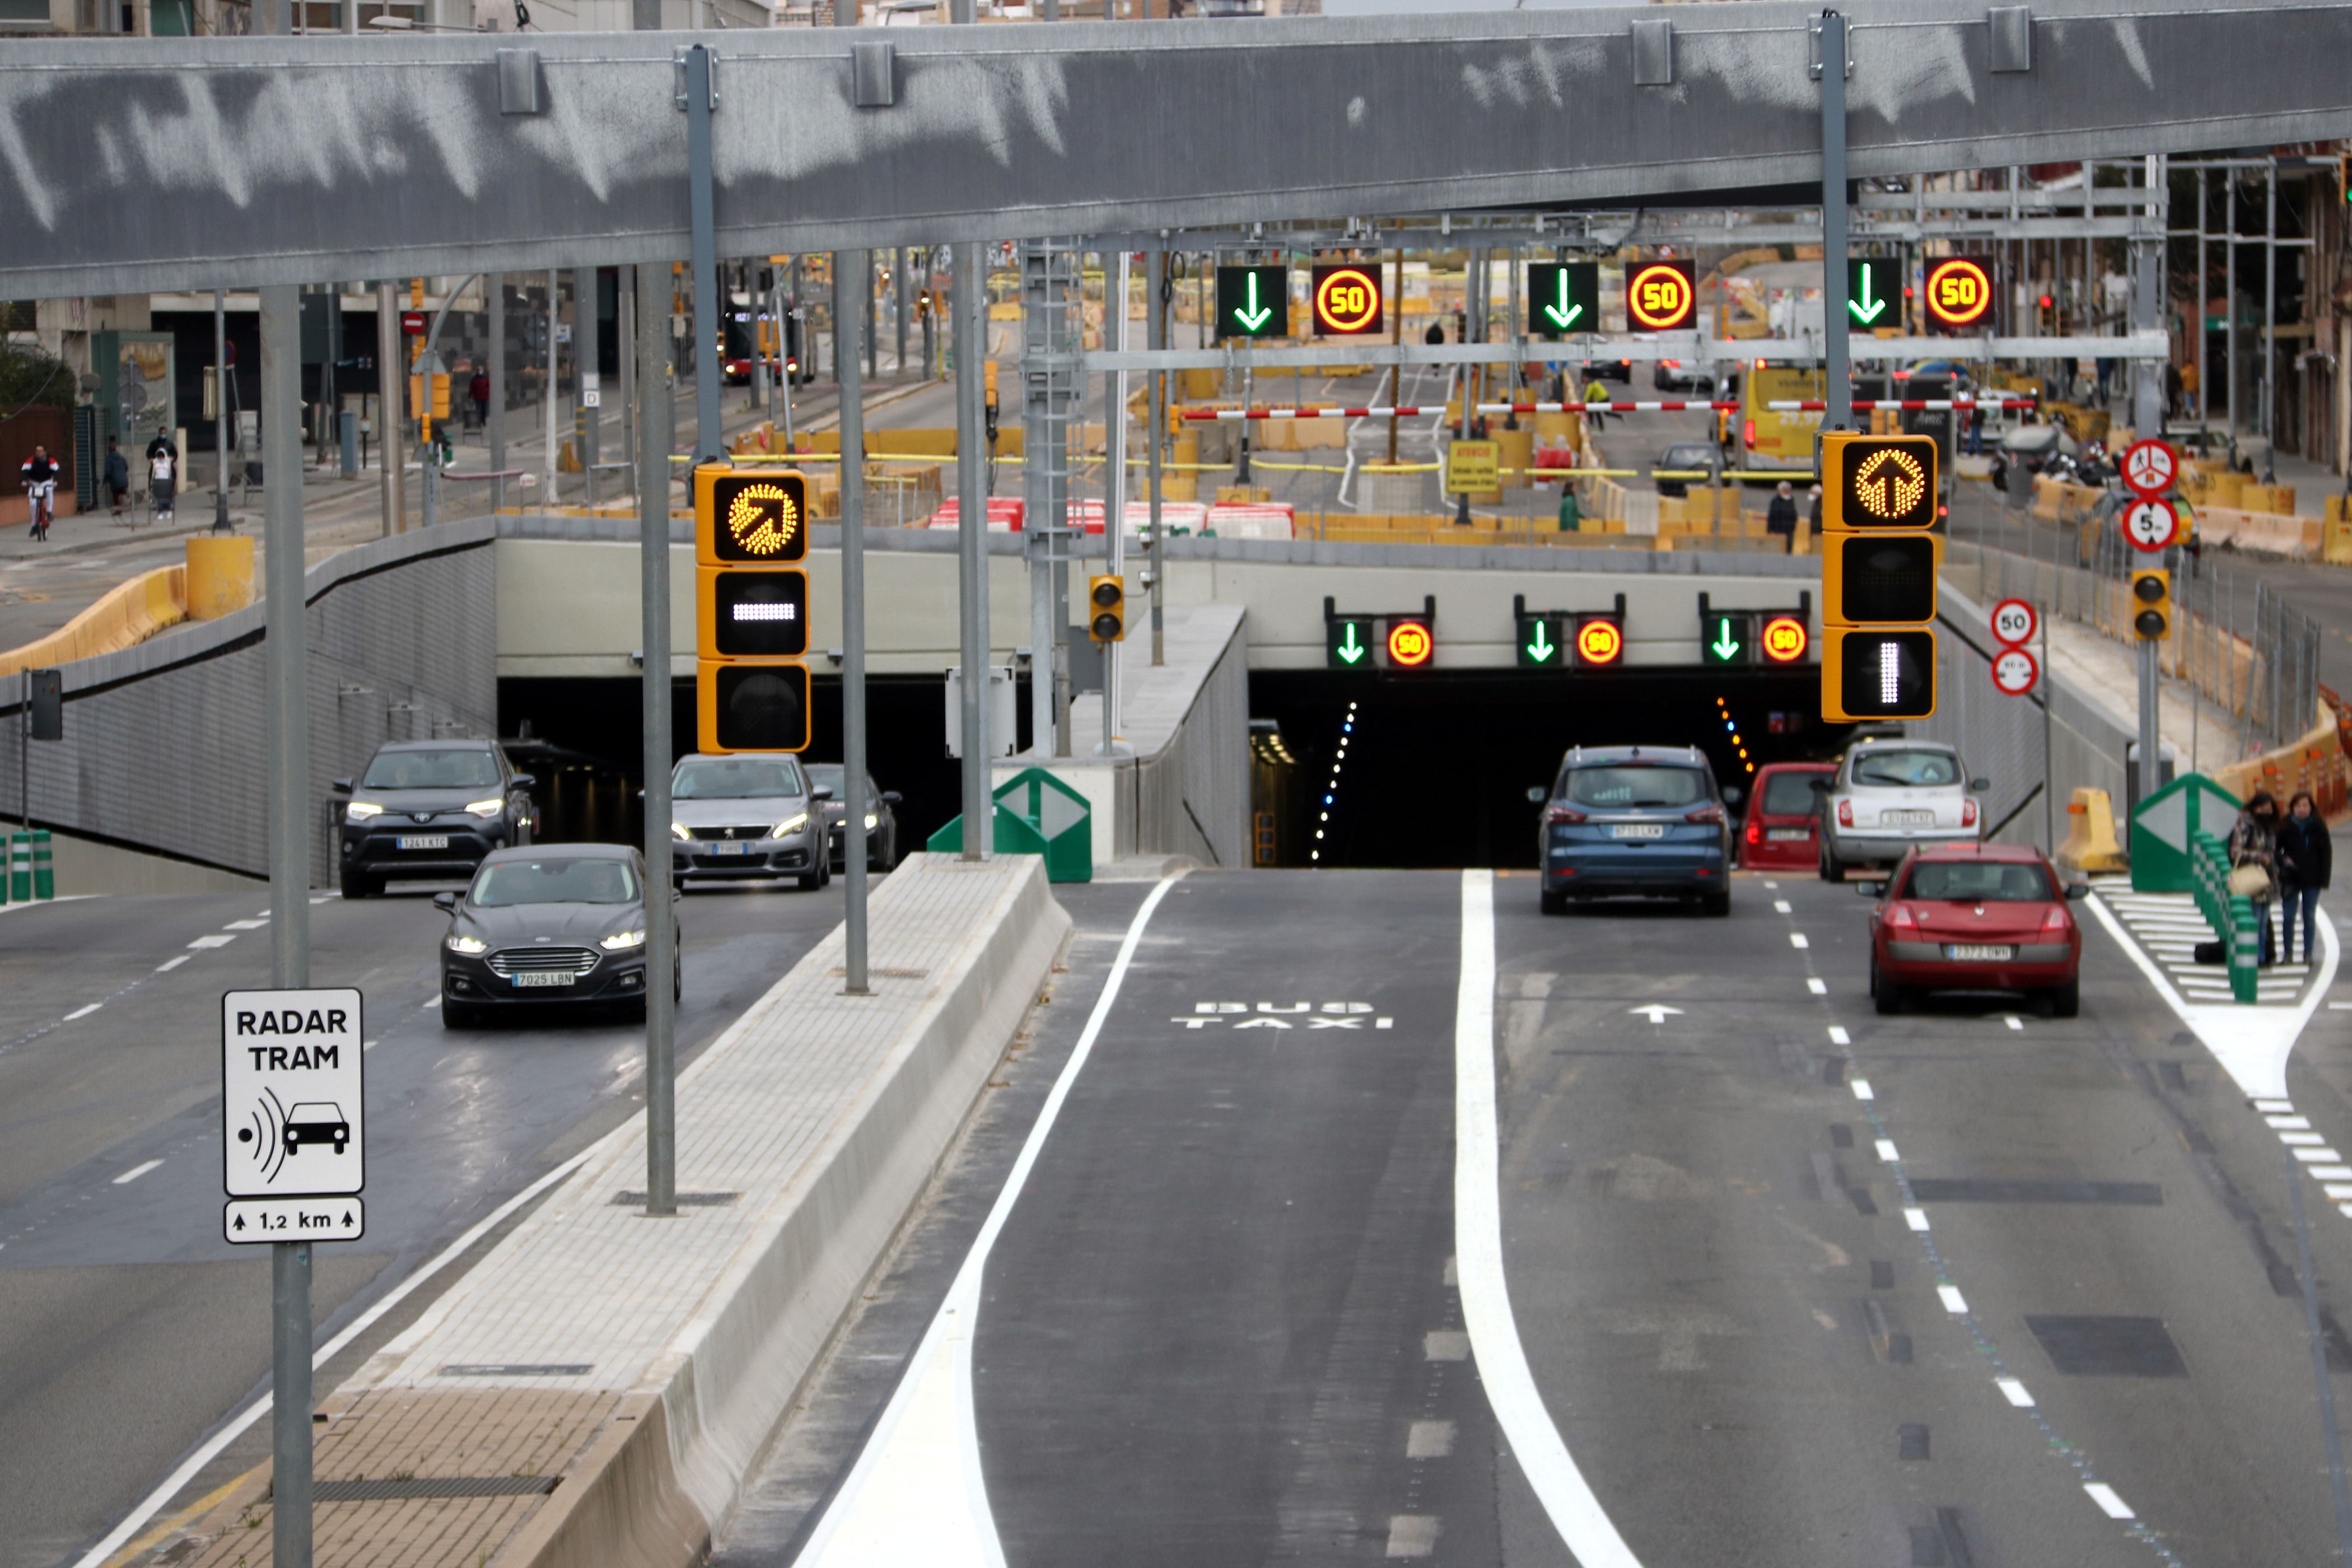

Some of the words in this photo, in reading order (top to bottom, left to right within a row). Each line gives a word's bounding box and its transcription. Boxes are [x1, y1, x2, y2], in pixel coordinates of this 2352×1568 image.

[1331, 287, 1364, 313] 50
[1644, 283, 1678, 310] 50
[1942, 278, 1976, 305] 50
[2141, 515, 2153, 531] 5
[2002, 614, 2026, 630] 50
[1398, 634, 1422, 654] 50
[1588, 632, 1611, 652] 50
[1773, 629, 1796, 649] 50
[520, 974, 547, 985] 7025
[551, 974, 571, 984] LBN
[1195, 1002, 1374, 1013] BUS
[237, 1010, 347, 1035] RADAR
[1171, 1017, 1393, 1028] TAXI
[248, 1045, 338, 1071] TRAM
[260, 1212, 287, 1231] 1,2
[298, 1211, 331, 1229] km
